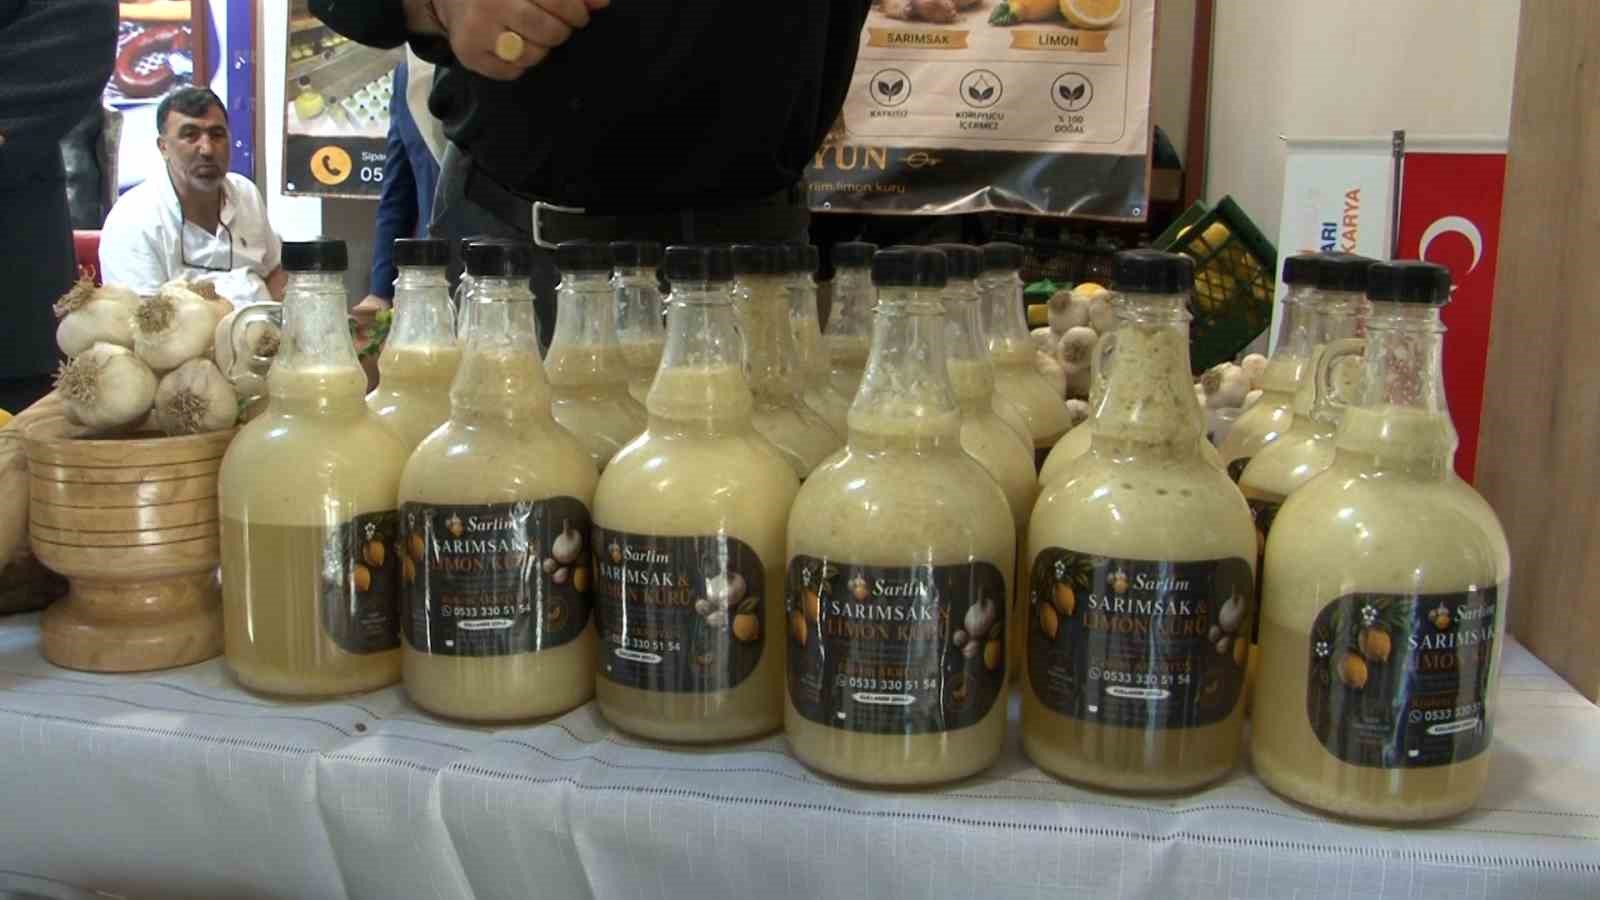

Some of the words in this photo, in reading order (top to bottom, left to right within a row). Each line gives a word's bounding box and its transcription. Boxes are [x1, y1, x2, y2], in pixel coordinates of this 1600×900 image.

[886, 32, 950, 45] SARIMSAK
[1068, 115, 1085, 124] 100
[360, 166, 384, 182] 05
[623, 544, 670, 565] Sarlim
[600, 561, 673, 587] SARMSAK
[1133, 572, 1190, 592] Sarlim
[454, 607, 478, 617] 0533
[831, 600, 933, 621] SARIMSAK
[1088, 593, 1191, 616] SARIMSAK
[849, 679, 876, 690] 0533
[880, 680, 901, 690] 330
[904, 680, 918, 691] 51
[923, 679, 936, 690] 54
[1103, 671, 1132, 683] 0533
[1136, 672, 1158, 685] 330
